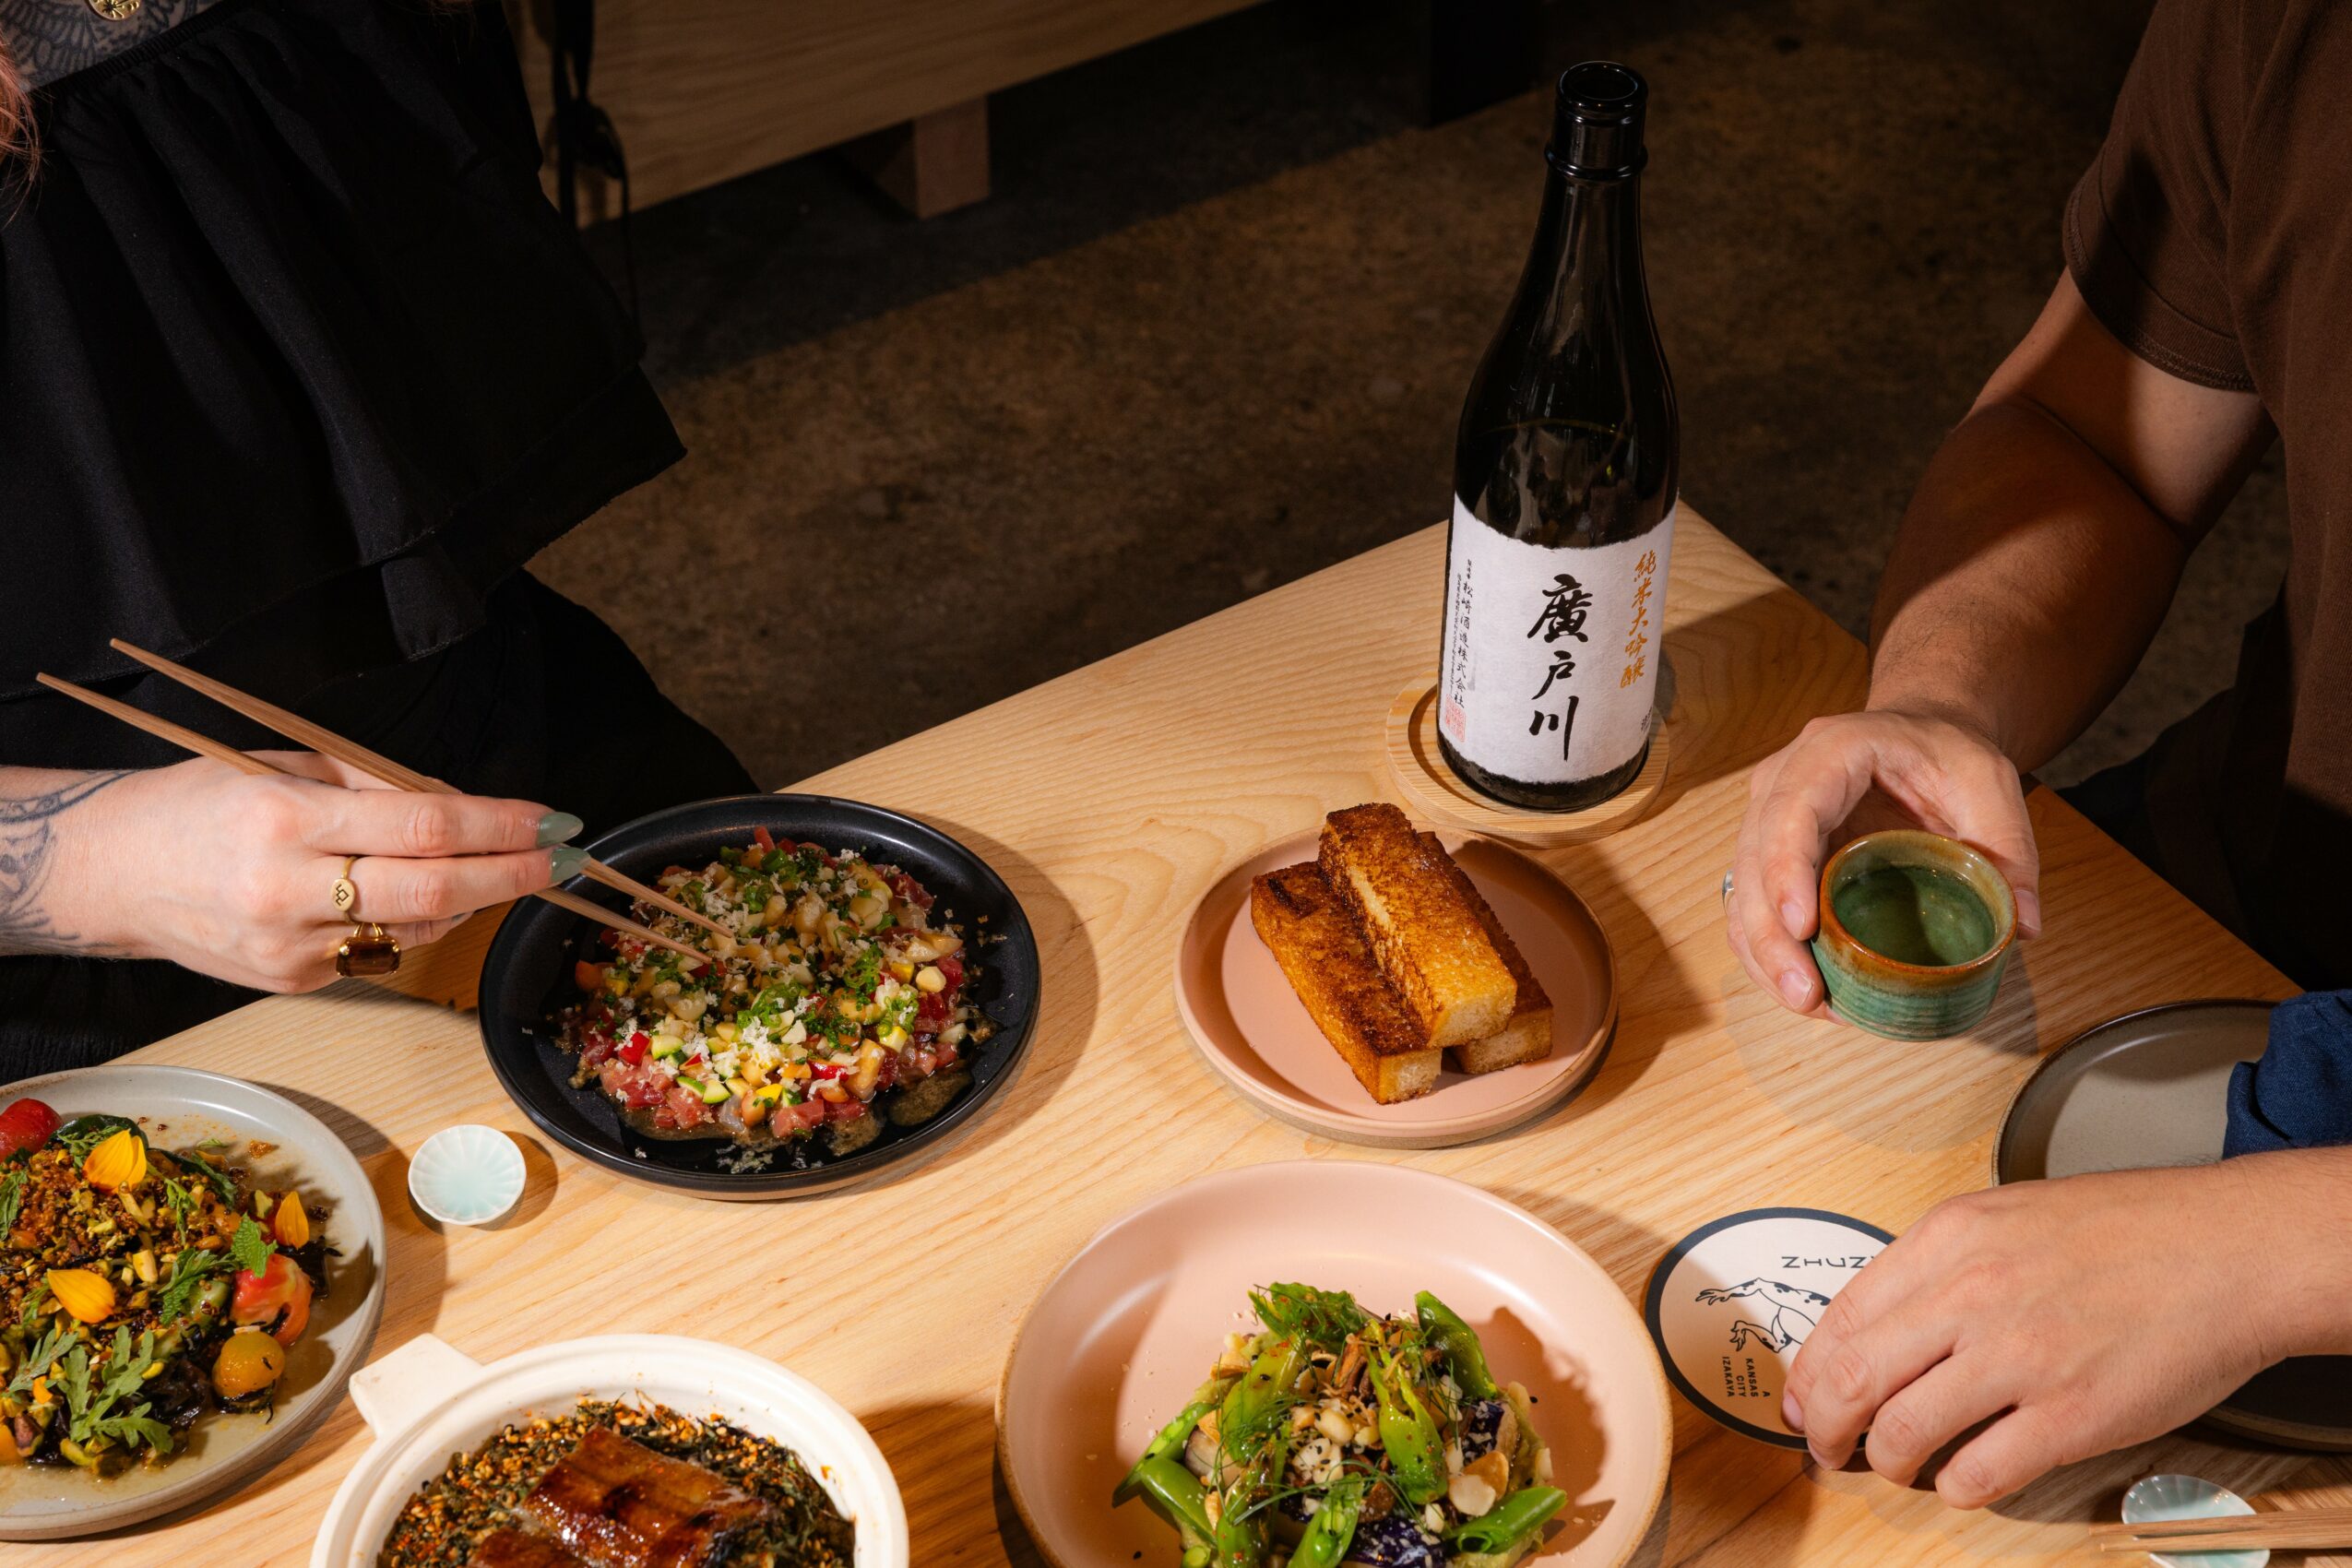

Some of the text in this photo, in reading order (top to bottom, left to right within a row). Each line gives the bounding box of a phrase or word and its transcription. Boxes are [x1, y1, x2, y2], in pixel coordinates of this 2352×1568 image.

[1526, 573, 1593, 762] 廣戸川
[1781, 1255, 1874, 1268] NJIN
[1722, 1356, 1735, 1397] IZAKAYA
[1736, 1375, 1747, 1397] CITY
[1746, 1358, 1759, 1397] KANSAS
